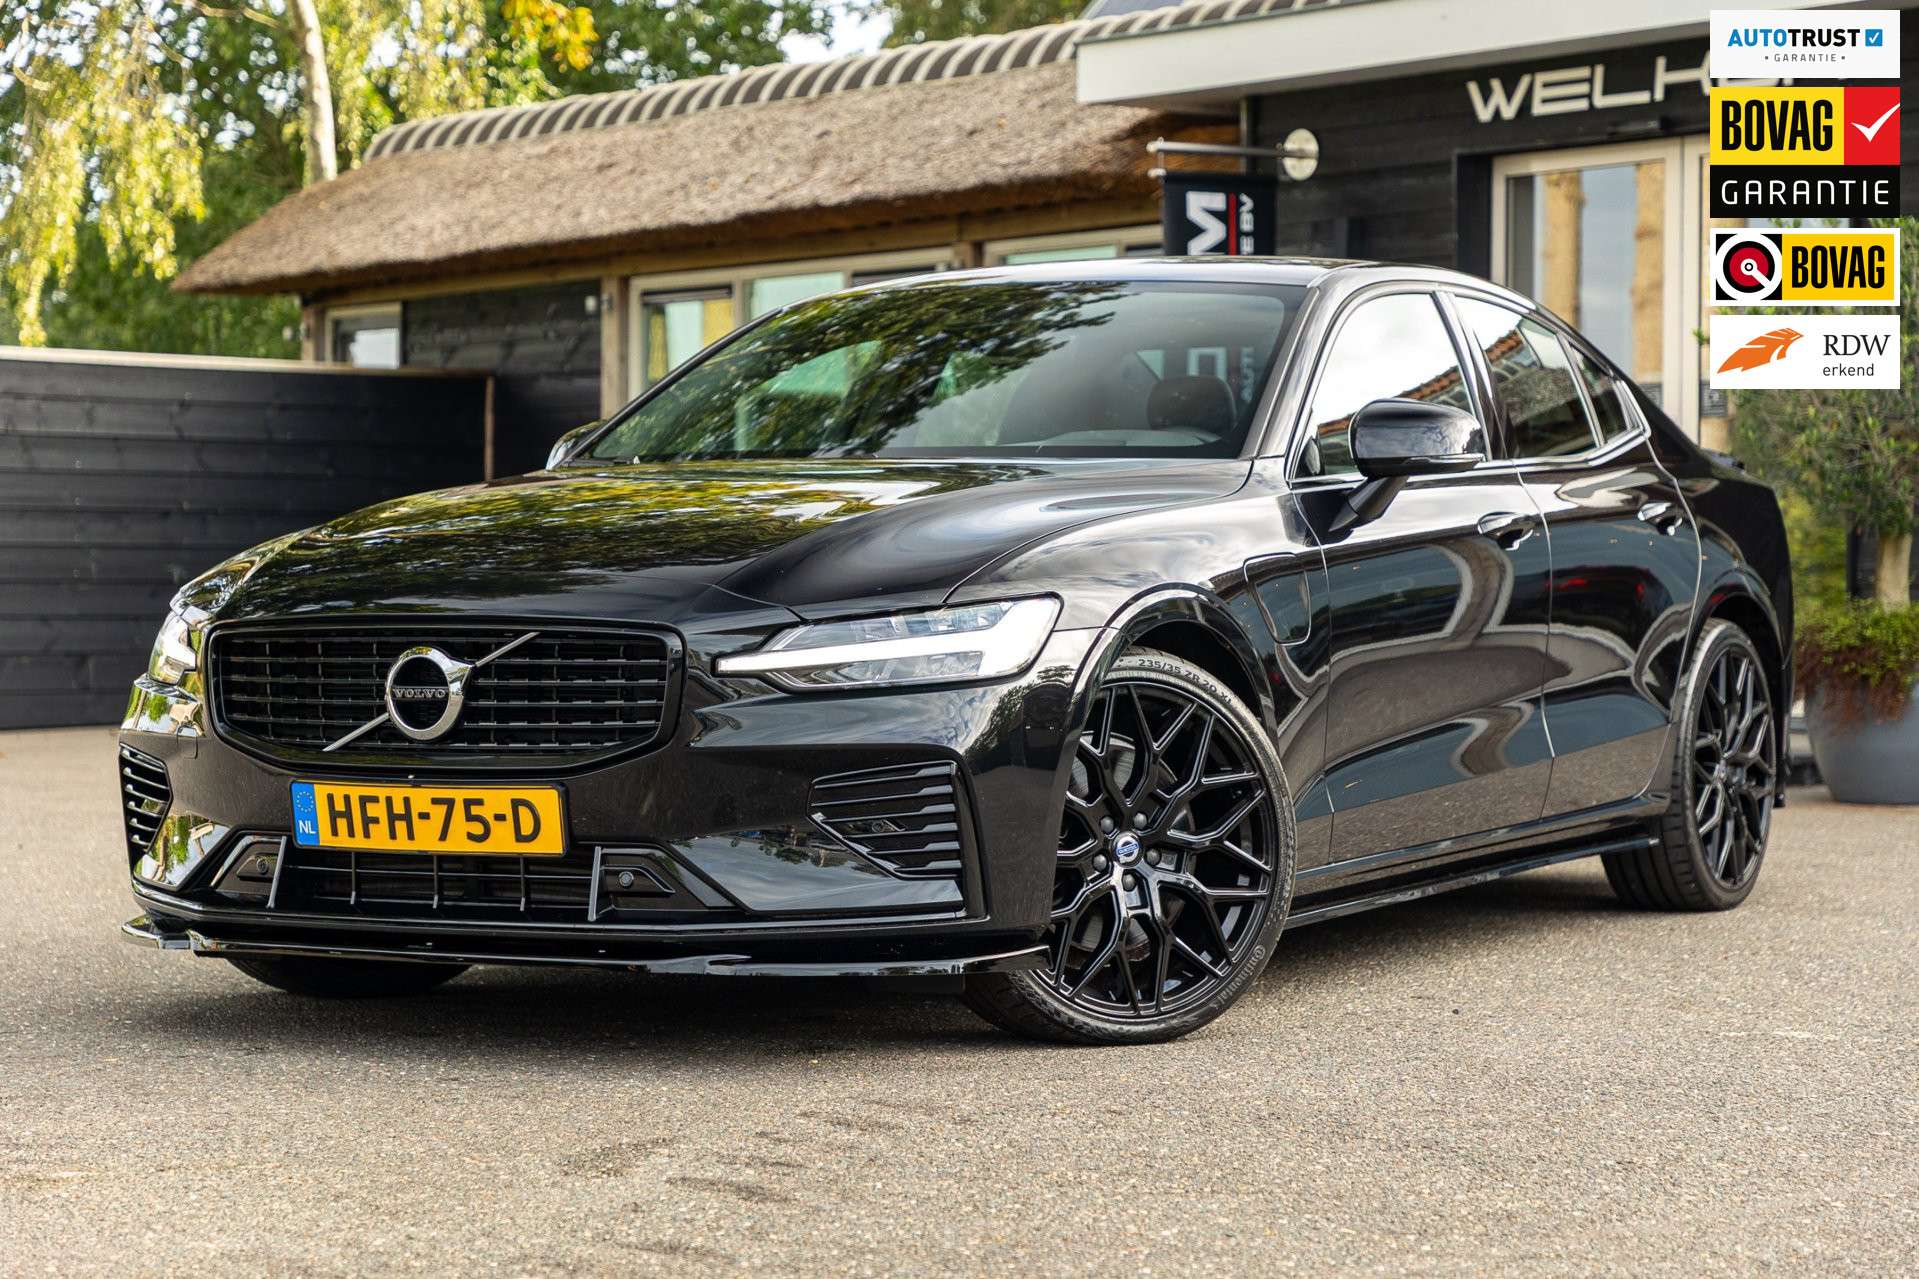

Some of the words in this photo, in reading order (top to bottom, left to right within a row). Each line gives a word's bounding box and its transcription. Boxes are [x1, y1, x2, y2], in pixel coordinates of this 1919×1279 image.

[1138, 658, 1182, 674] 235/35
[1184, 669, 1201, 683] ZR
[1202, 679, 1217, 693] 20
[393, 687, 447, 699] VOLVO
[299, 819, 317, 835] NL
[326, 792, 542, 844] HFH-75-D
